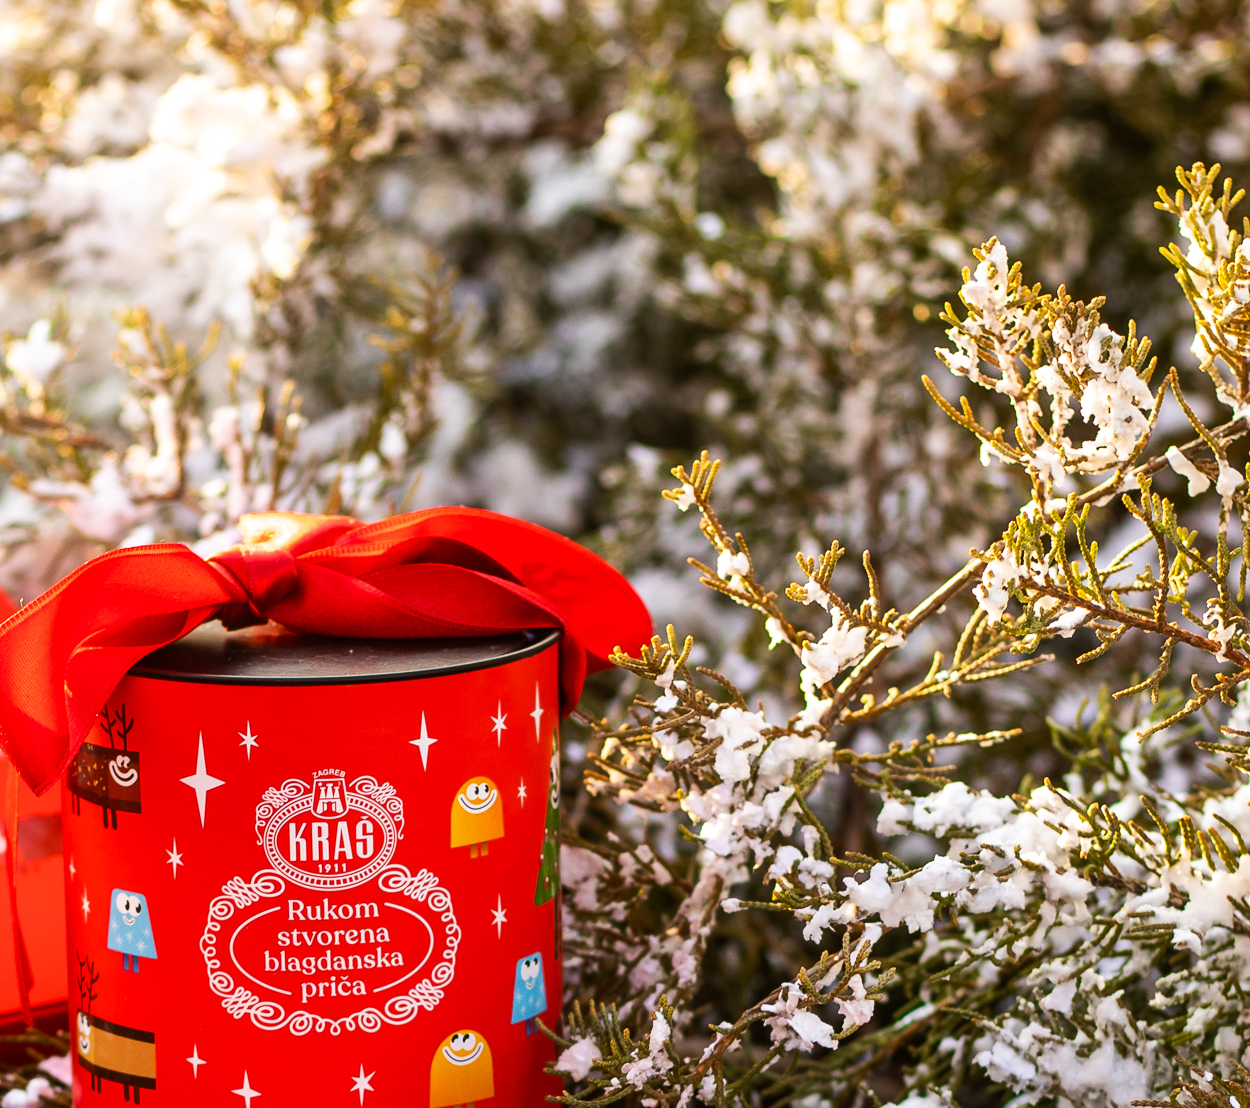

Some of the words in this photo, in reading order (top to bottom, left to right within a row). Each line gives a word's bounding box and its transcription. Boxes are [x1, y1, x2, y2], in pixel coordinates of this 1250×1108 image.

[312, 768, 346, 778] ZAGREB
[288, 816, 374, 861] KRAŠ
[317, 863, 347, 873] 1911
[287, 898, 379, 921] Rukom
[277, 926, 390, 946] stvorena
[264, 947, 404, 975] blagdanska
[301, 976, 367, 1003] priča
